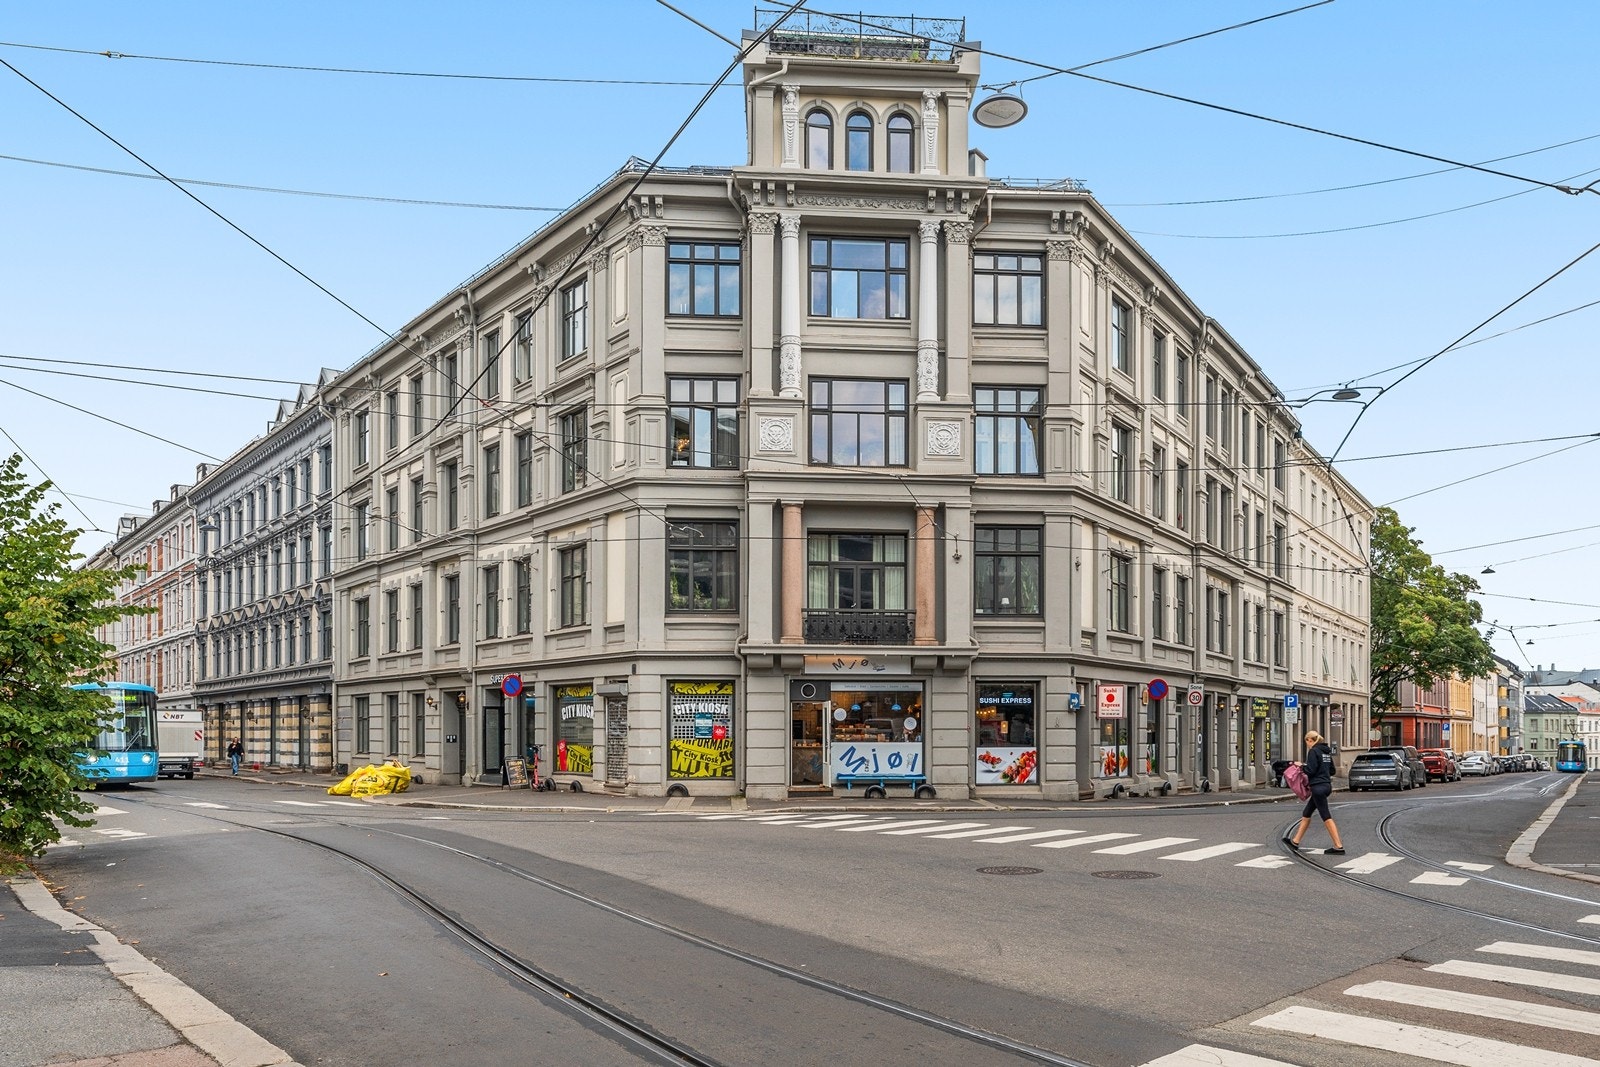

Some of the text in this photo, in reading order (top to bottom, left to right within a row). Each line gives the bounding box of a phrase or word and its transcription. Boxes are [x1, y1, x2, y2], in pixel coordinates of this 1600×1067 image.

[1191, 694, 1200, 702] 30
[1287, 696, 1295, 706] P
[561, 705, 576, 720] CITY
[674, 703, 729, 715] CITY KIOSK
[569, 749, 579, 761] City
[683, 749, 698, 761] City
[699, 752, 719, 764] Kiosk
[839, 745, 919, 773] Mjøl
